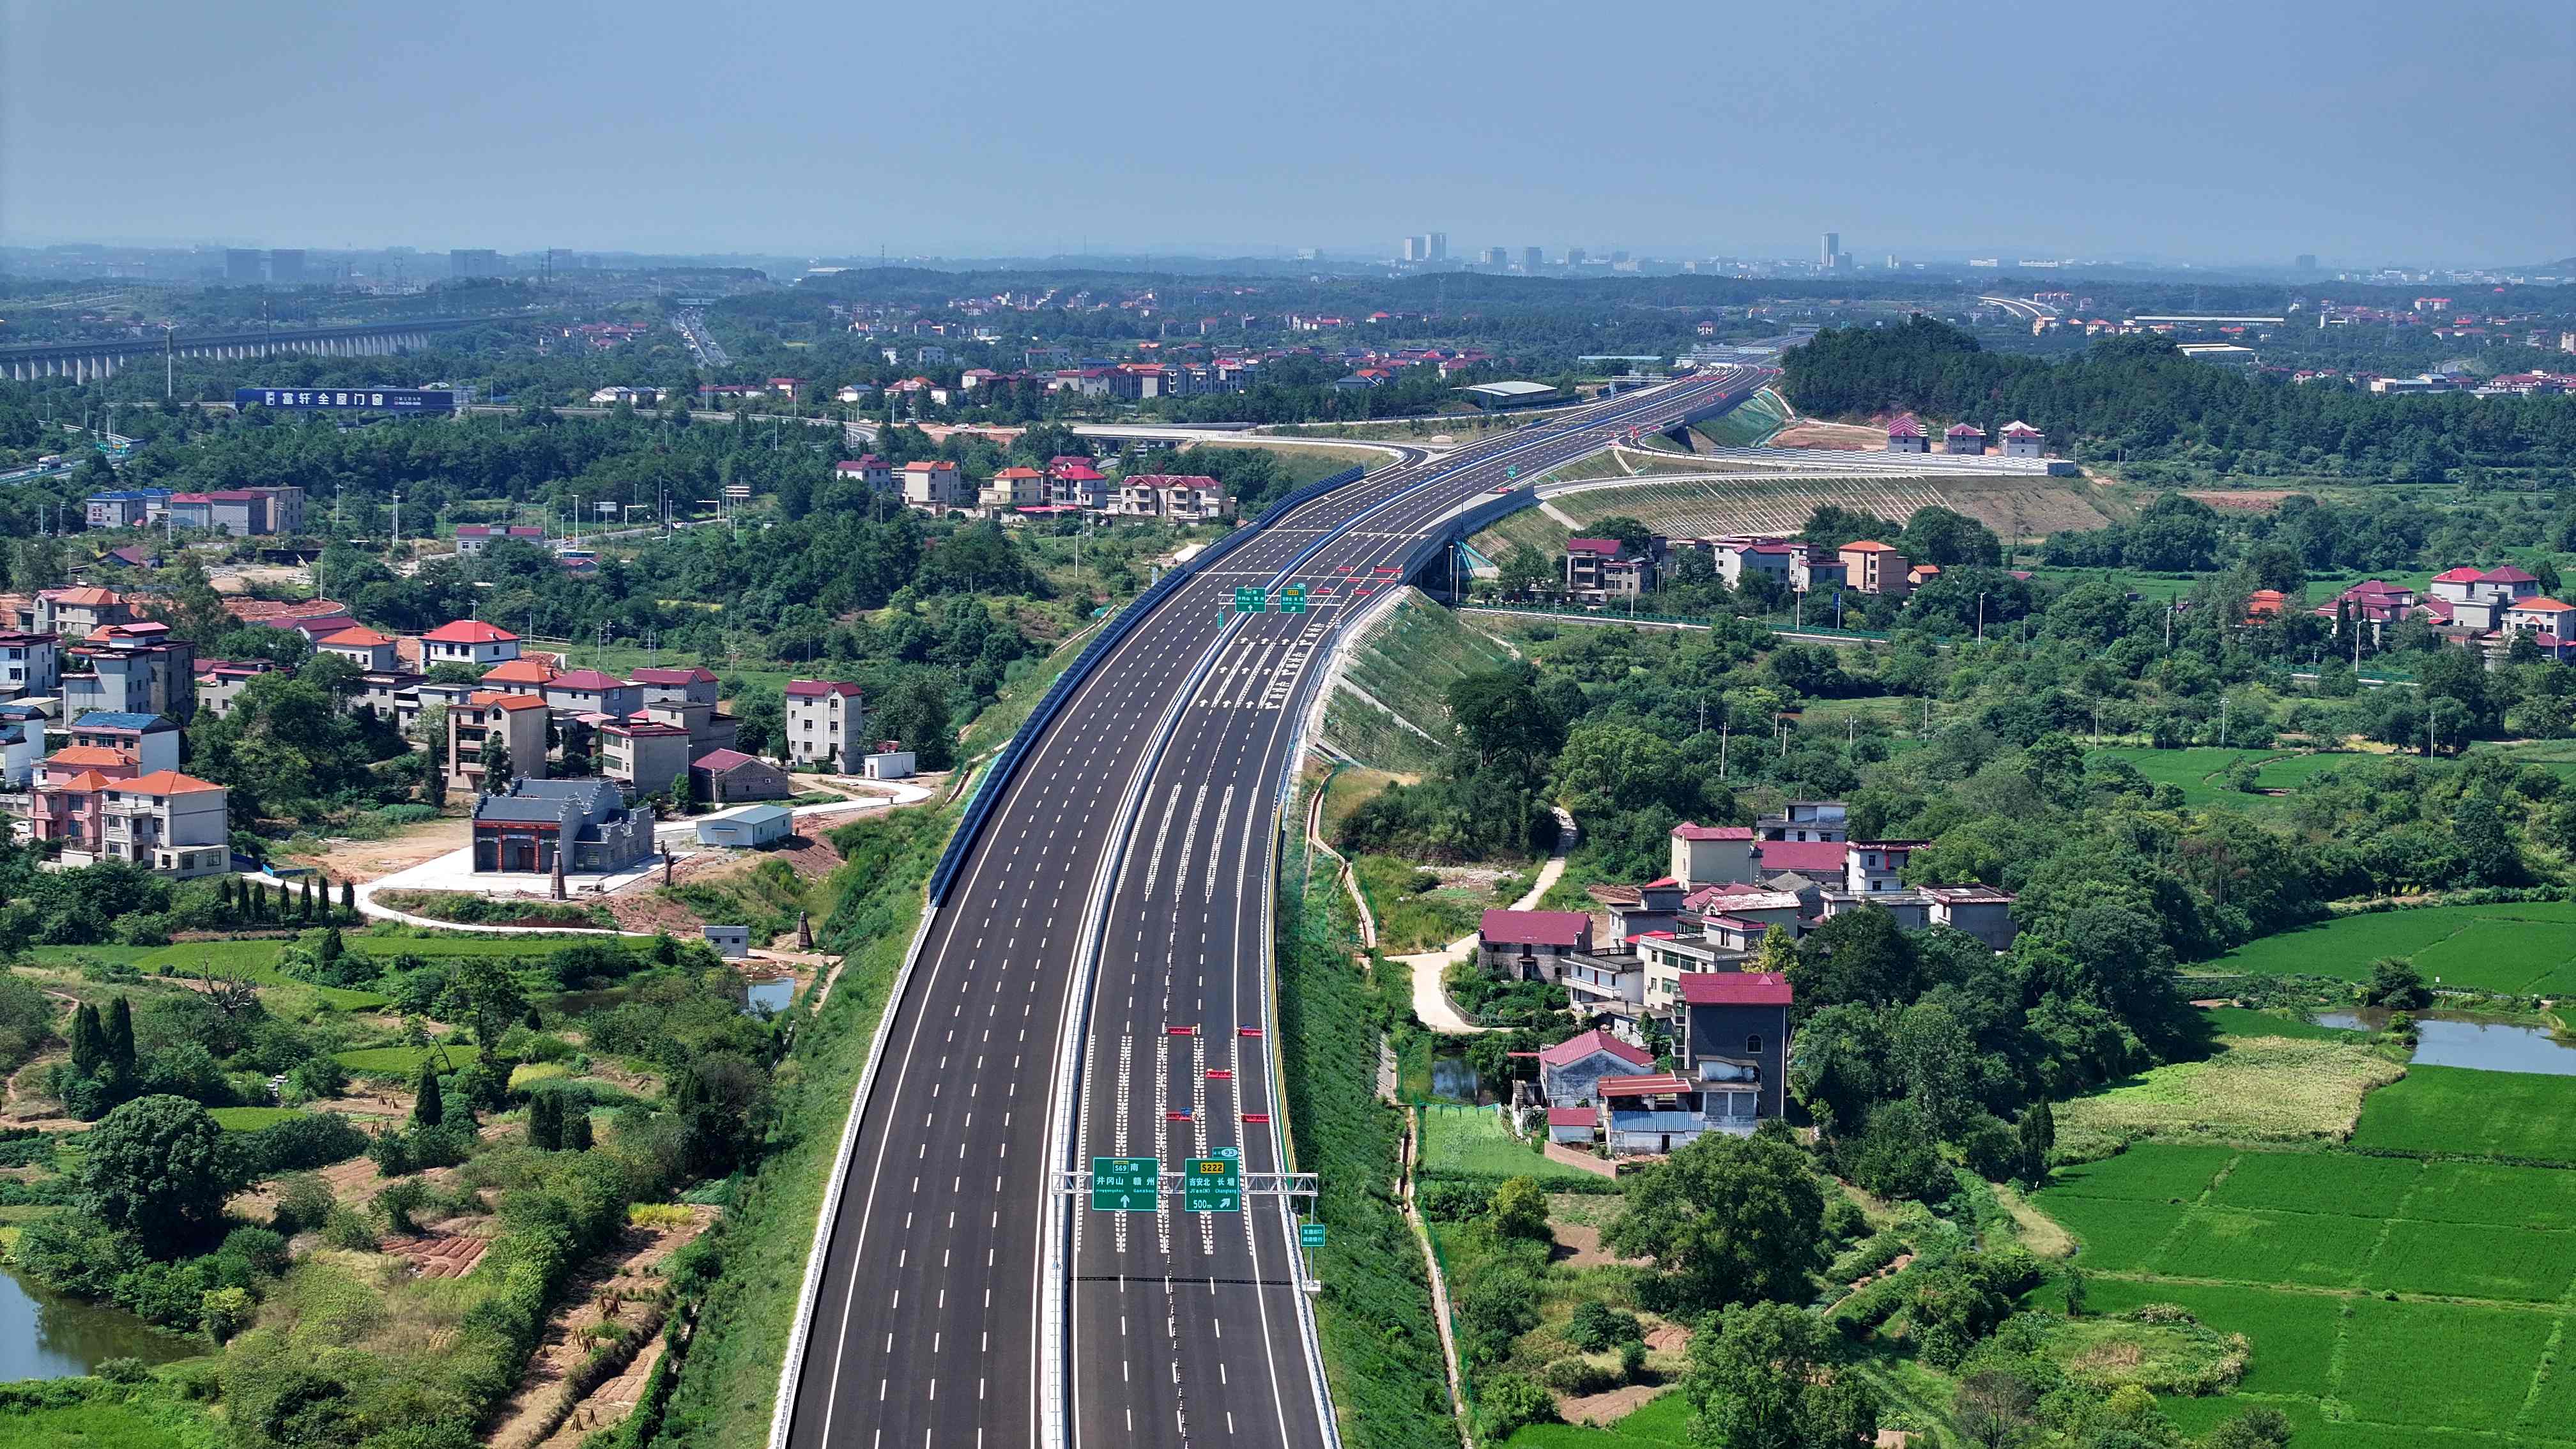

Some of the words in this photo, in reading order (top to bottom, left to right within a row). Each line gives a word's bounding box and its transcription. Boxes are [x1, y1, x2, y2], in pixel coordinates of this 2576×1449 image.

[282, 393, 383, 405] 富轩全屋门窗
[1130, 1163, 1139, 1172] 南
[1096, 1176, 1124, 1186] 井冈山
[1189, 1177, 1211, 1186] 吉安北
[1193, 1200, 1212, 1209] 500m
